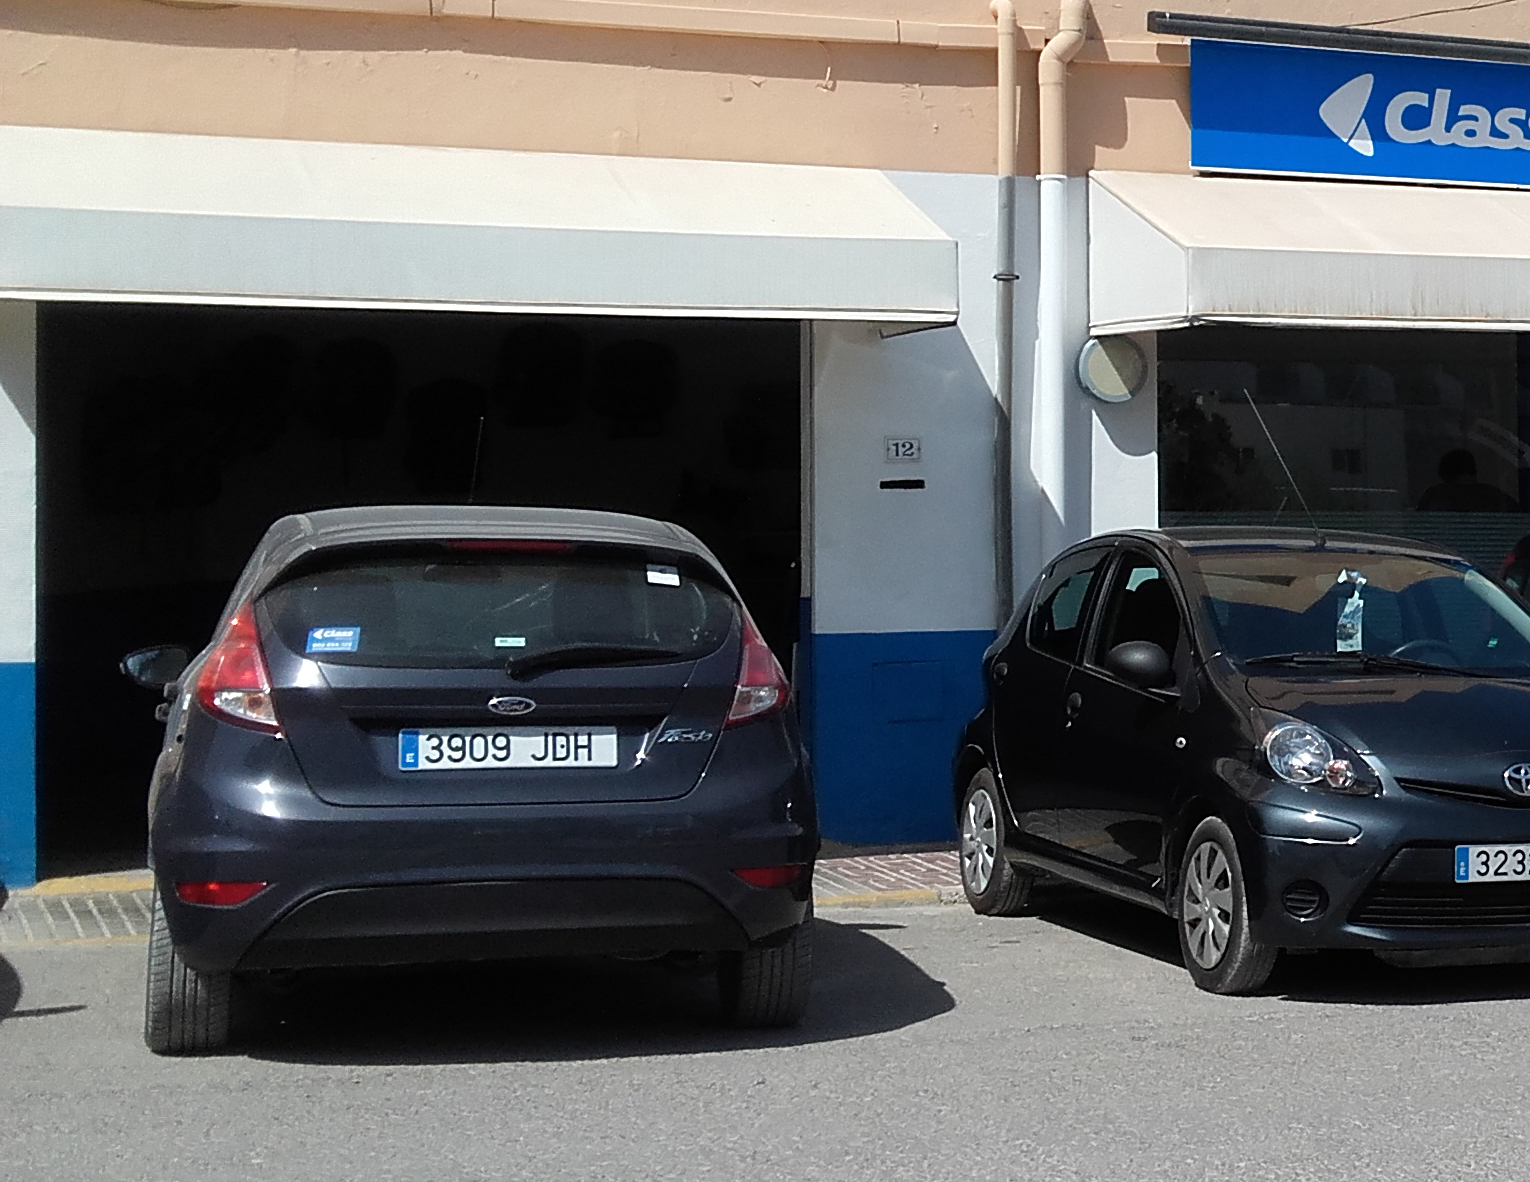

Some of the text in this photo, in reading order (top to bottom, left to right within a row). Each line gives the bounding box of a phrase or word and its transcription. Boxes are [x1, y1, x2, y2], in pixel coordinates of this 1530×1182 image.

[892, 441, 915, 457] 12
[498, 700, 526, 711] Ford
[424, 732, 512, 764] 3909
[531, 732, 593, 762] JDH
